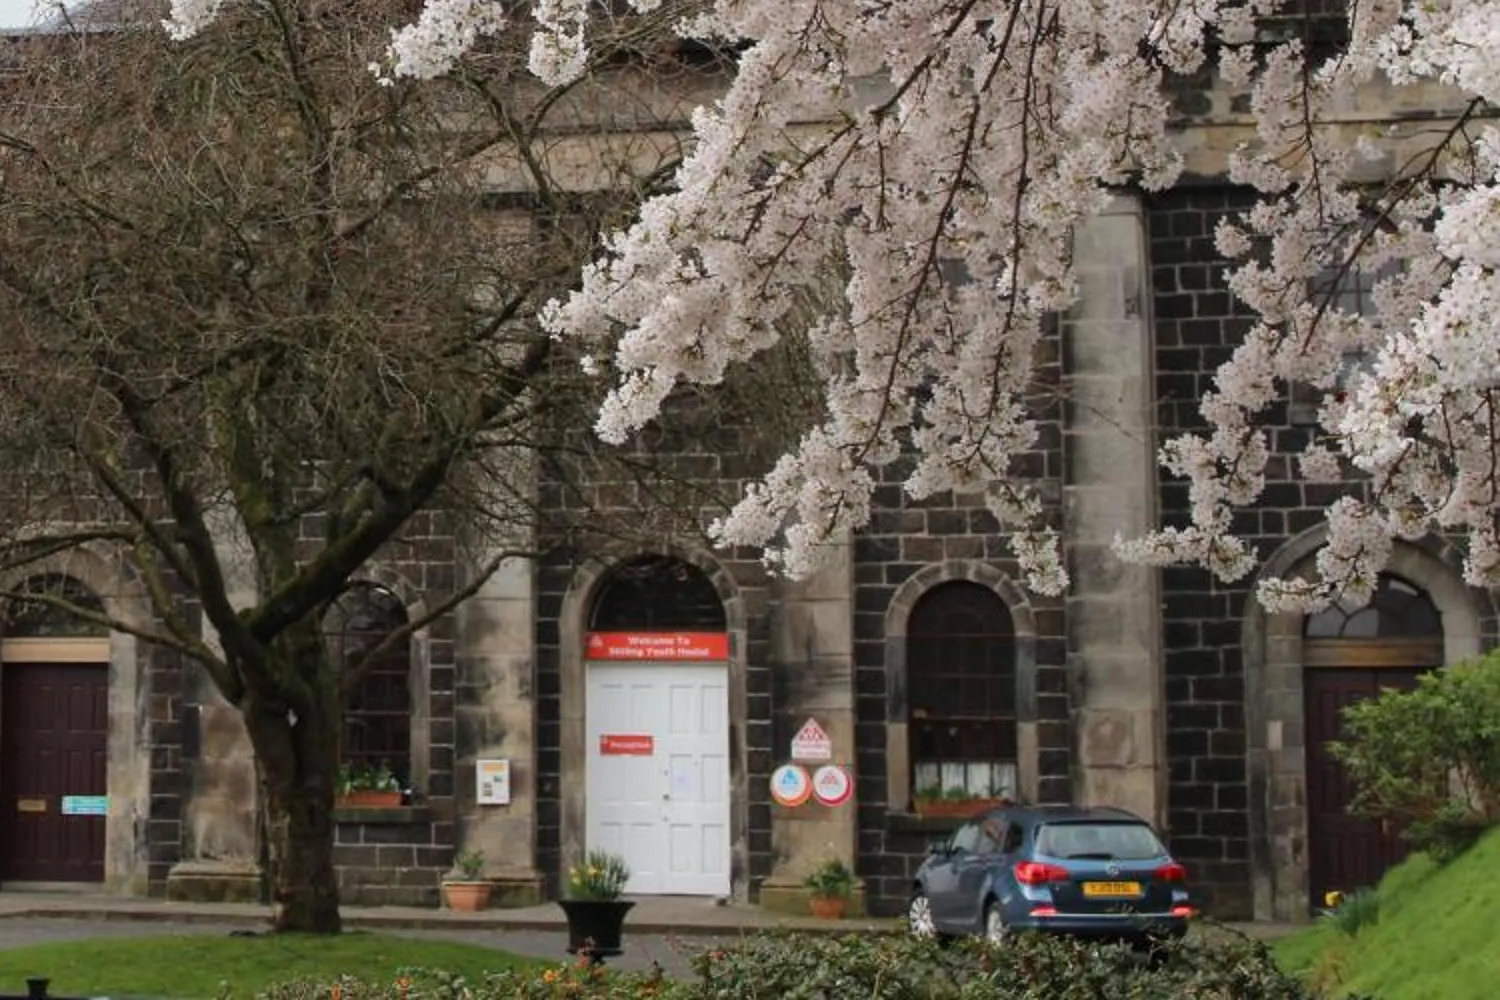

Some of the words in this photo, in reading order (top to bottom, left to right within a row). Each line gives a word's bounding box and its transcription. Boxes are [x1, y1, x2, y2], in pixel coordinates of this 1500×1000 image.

[627, 636, 675, 645] Welcome
[609, 647, 644, 658] Stirling
[646, 647, 676, 656] Youth
[678, 647, 709, 656] Hostel
